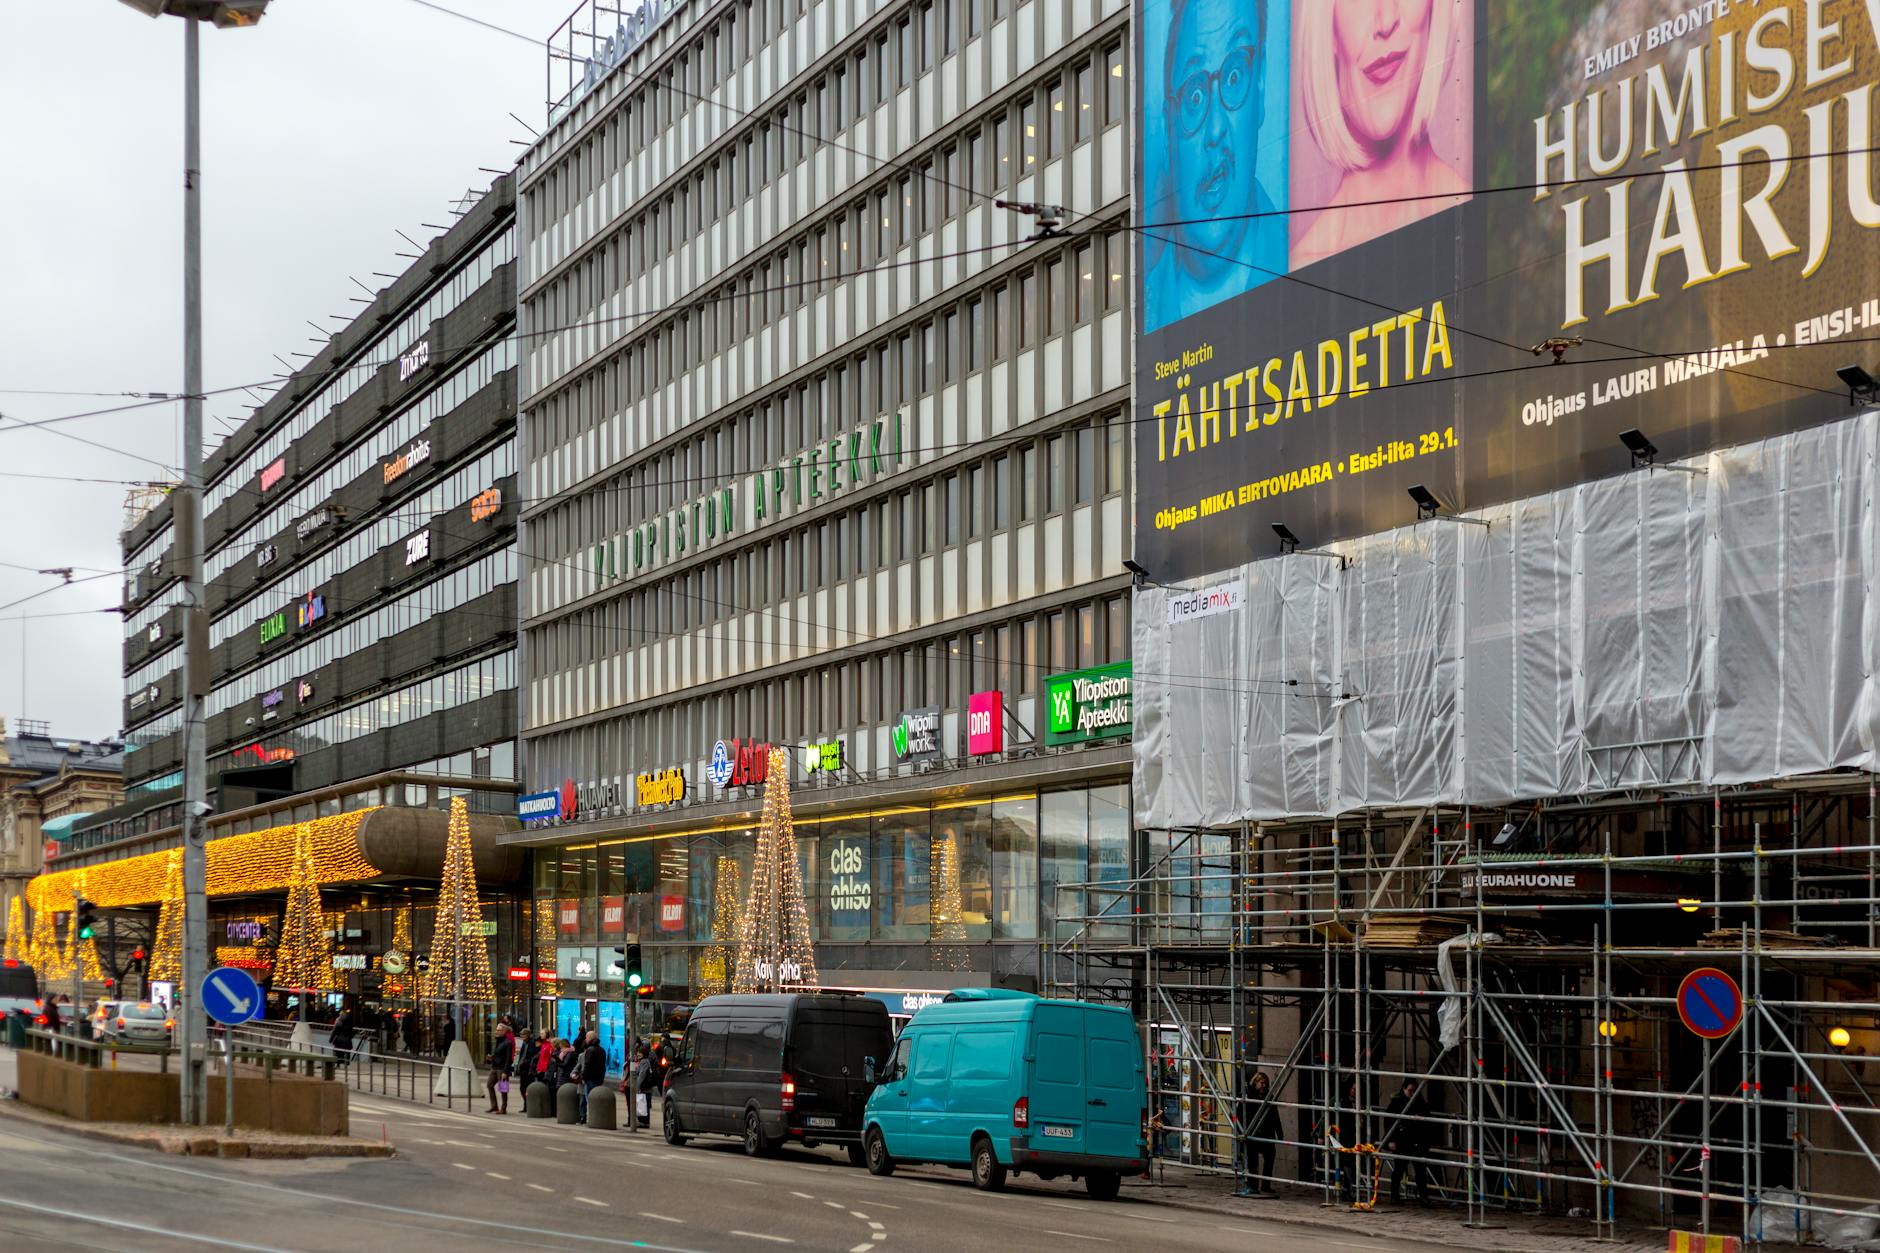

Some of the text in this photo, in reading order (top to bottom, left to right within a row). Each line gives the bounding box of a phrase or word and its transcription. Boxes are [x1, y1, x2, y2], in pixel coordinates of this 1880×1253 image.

[1584, 33, 1642, 80] EMILY
[1533, 0, 1880, 202] HUMISE
[1155, 343, 1213, 381] Steve Martin
[1153, 300, 1454, 463] TÄHTISADETTA
[1522, 390, 1587, 427] Ohjaus
[1592, 363, 1657, 406] LAURI
[1664, 333, 1769, 385] MAIJALA
[1155, 426, 1458, 530] Ohjaus MIKA EIRTOVAARA Ensi-ilta 29.1.
[595, 413, 903, 585] YLIOPISTON APTEEKKI
[405, 529, 429, 566] ZURE
[1173, 588, 1237, 620] mediamix.fi
[1073, 676, 1128, 703] Yliopiston
[970, 710, 991, 736] DNA
[1077, 699, 1128, 736] Apteekki
[908, 731, 932, 754] work
[519, 796, 556, 815] MATKAHUOLTO
[578, 784, 616, 812] HUAWEI
[831, 839, 862, 875] clas
[663, 904, 682, 921] KILROY
[227, 921, 261, 939] CITYCENTER
[755, 957, 801, 982] Kaivpiha
[903, 993, 918, 1010] clas
[1220, 1038, 1229, 1050] 10
